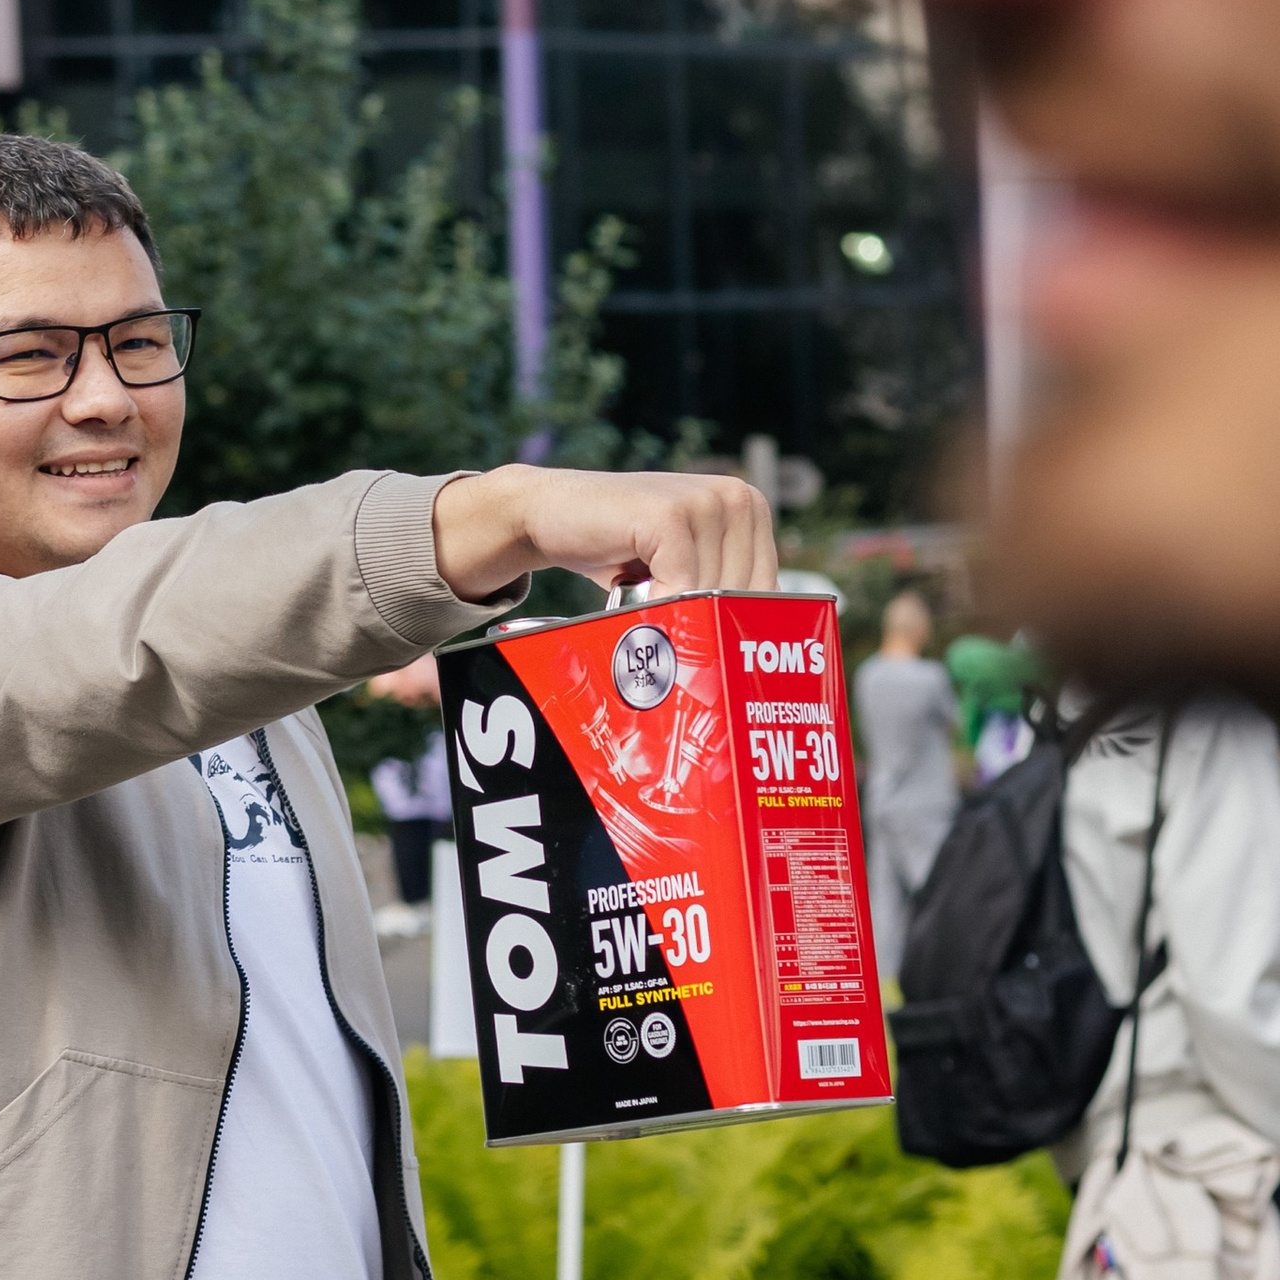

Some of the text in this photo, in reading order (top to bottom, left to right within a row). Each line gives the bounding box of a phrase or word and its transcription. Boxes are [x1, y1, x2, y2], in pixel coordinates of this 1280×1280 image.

[626, 643, 660, 673] LSPI
[739, 638, 826, 675] TOM'S
[634, 672, 657, 689] 対応
[745, 701, 834, 725] PROFESSIONAL
[748, 730, 840, 782] 5W-30
[757, 795, 843, 808] FULL SYNTHETIC
[231, 854, 303, 863] You Can Learn
[454, 694, 569, 1084] TOM'S
[587, 871, 705, 915] PROFESSIONAL
[590, 903, 711, 979] 5W-30
[599, 981, 714, 1011] FULL SYNTHETIC
[615, 1096, 658, 1109] MADE IN JAPAN
